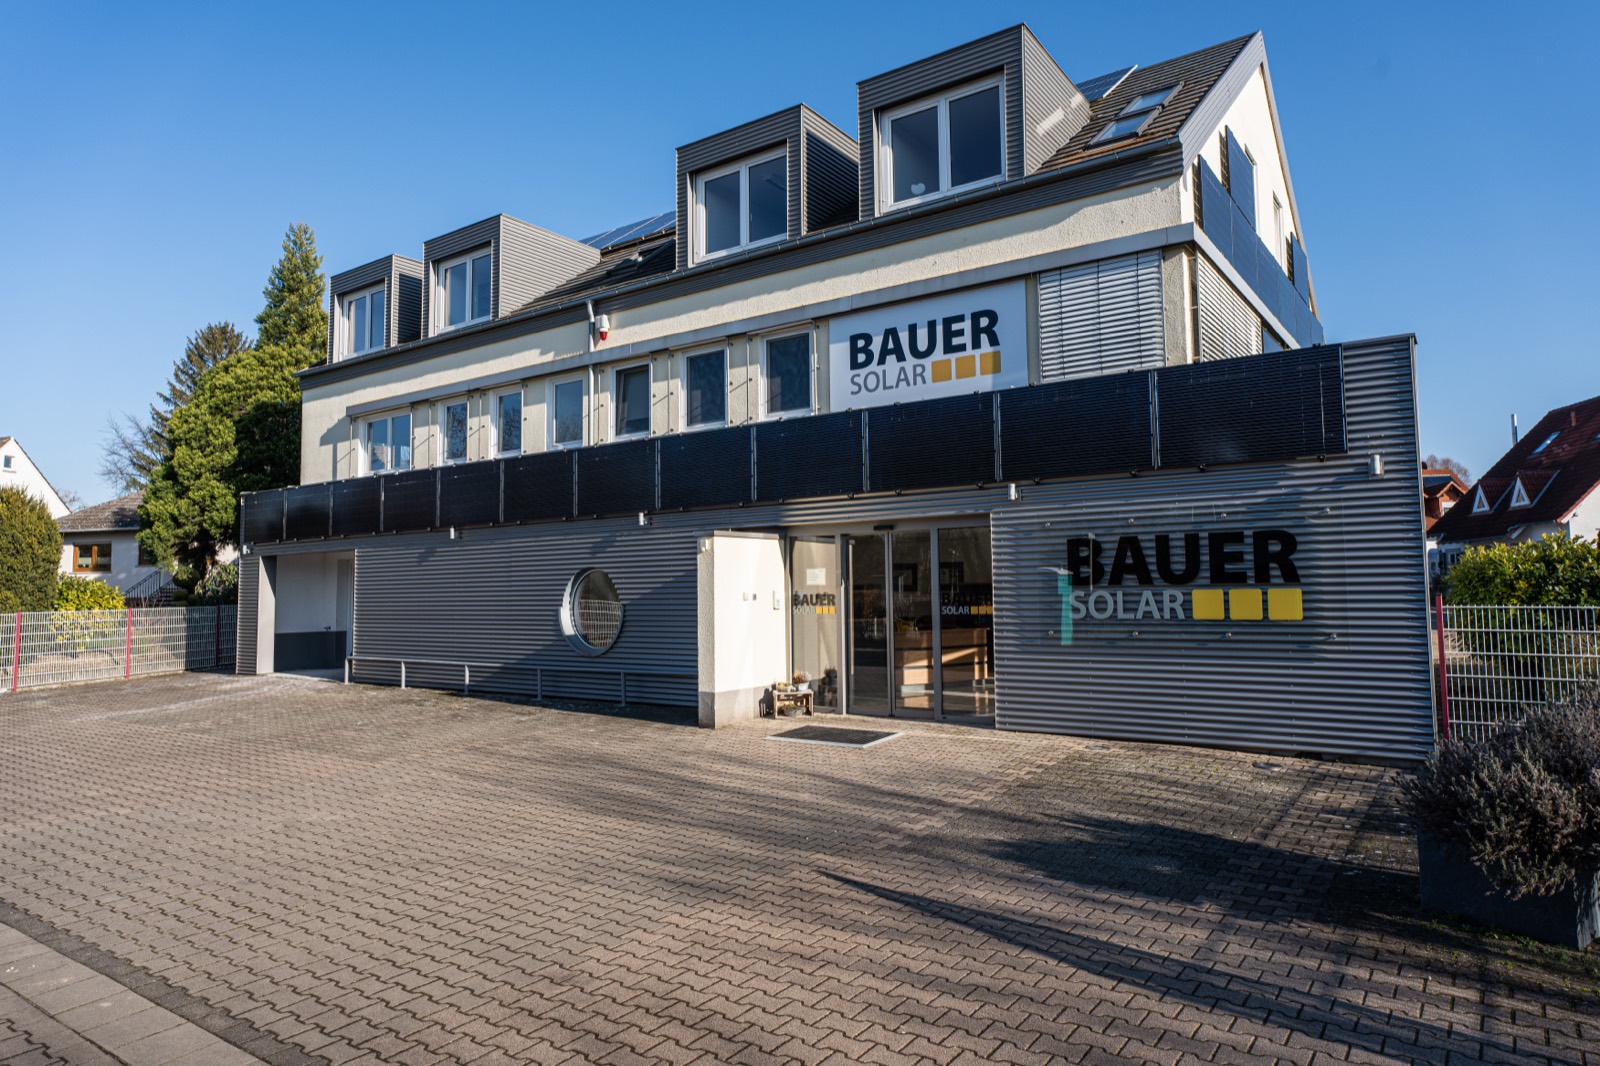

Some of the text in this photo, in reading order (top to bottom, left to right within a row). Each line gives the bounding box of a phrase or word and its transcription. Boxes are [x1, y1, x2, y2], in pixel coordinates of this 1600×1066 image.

[850, 309, 1000, 370] BAUER
[850, 363, 927, 395] SOLAR
[1066, 530, 1302, 586] BAUER
[793, 593, 836, 606] BAUER
[941, 605, 970, 615] SOLAR
[1069, 590, 1186, 620] SOLAR
